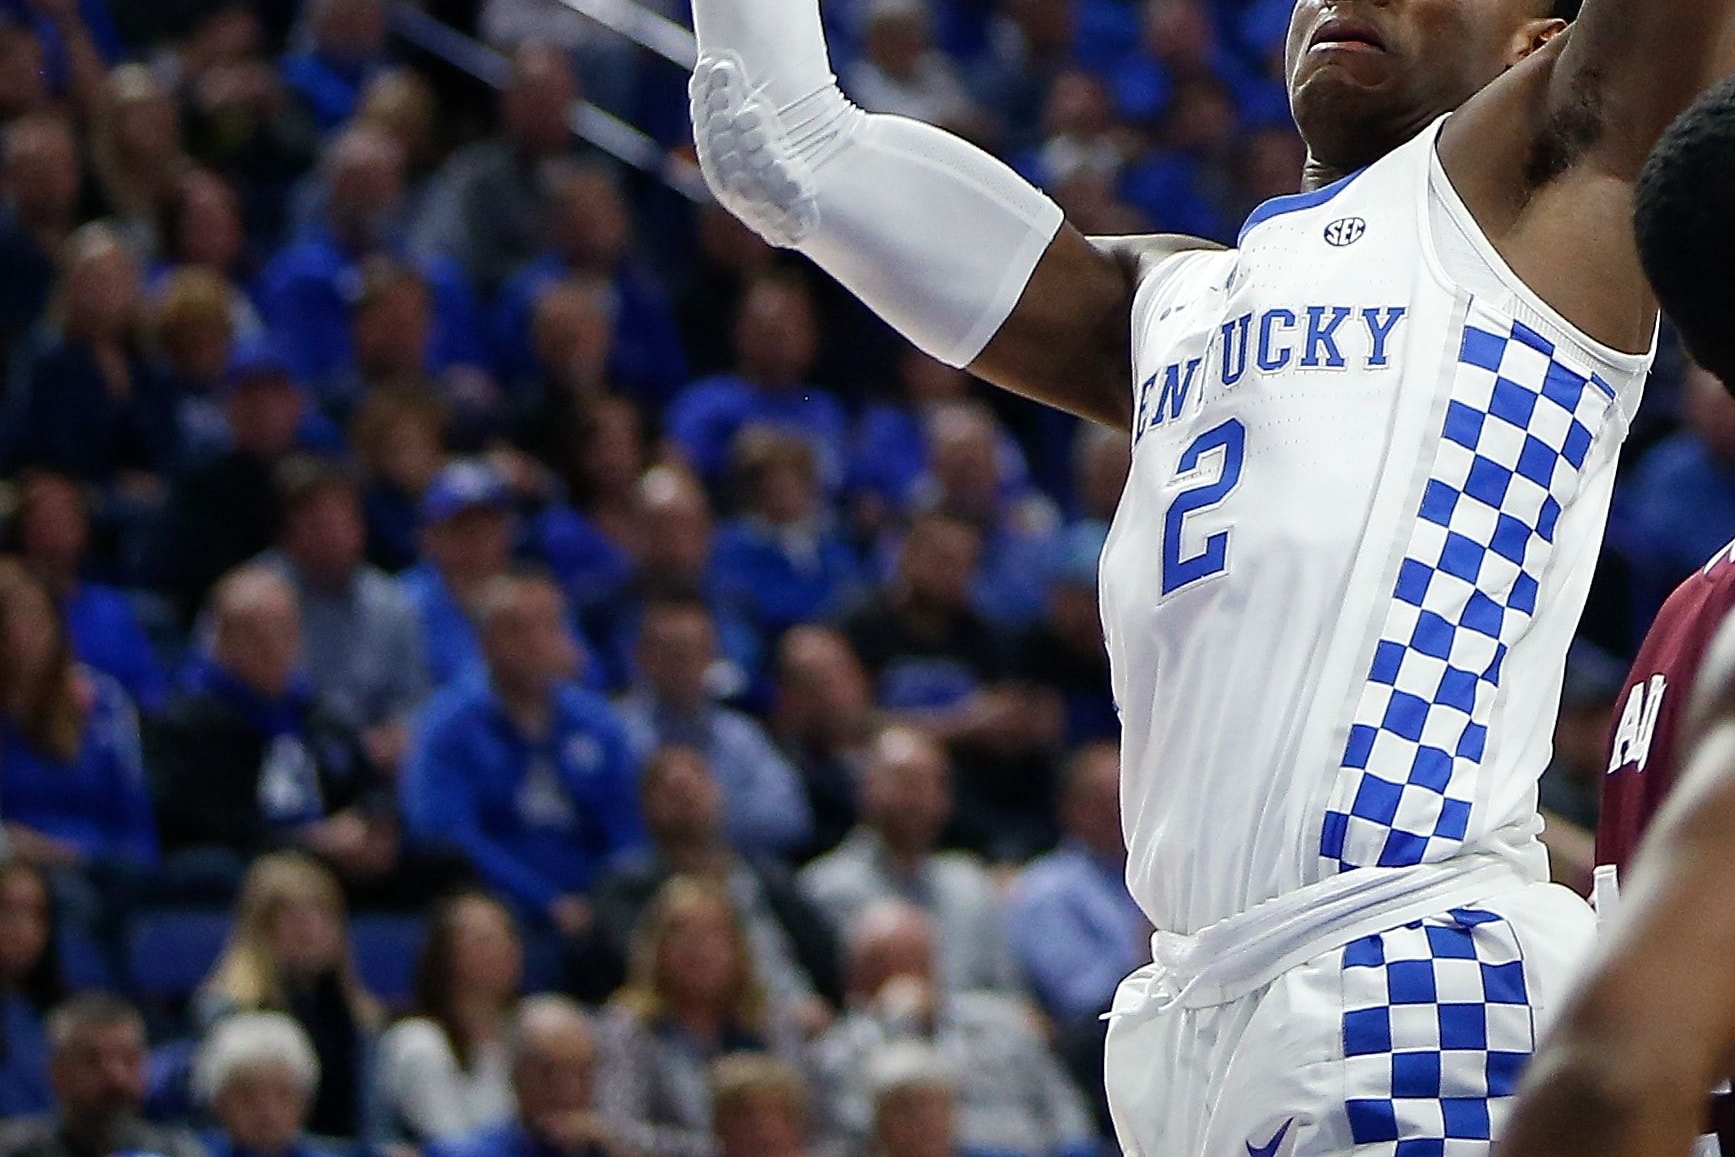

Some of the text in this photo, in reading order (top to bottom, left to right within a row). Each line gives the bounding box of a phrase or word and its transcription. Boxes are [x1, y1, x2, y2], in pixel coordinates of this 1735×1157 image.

[1325, 217, 1366, 246] SEC
[1135, 306, 1406, 444] ENUCKY
[1162, 417, 1246, 596] 2
